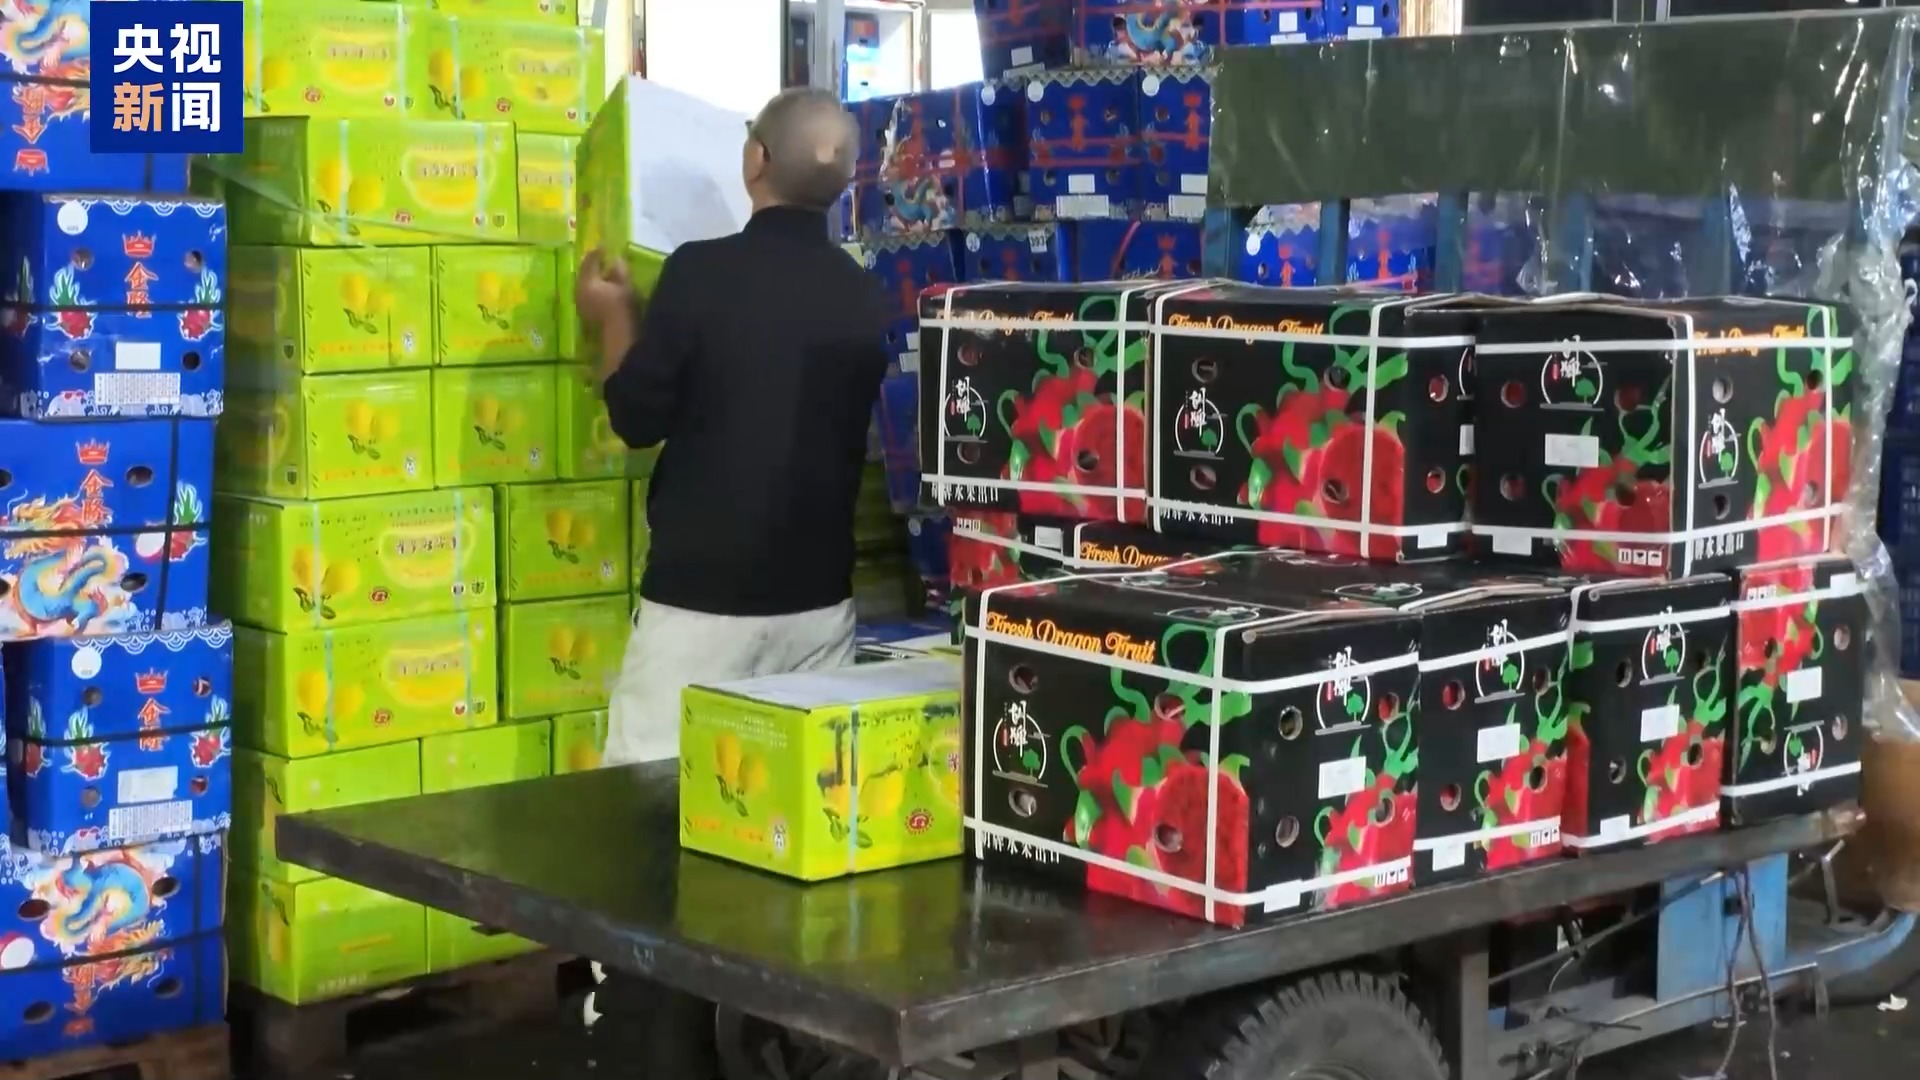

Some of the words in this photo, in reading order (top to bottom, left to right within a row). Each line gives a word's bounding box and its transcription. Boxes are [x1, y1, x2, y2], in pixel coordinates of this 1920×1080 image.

[987, 611, 1034, 639] Fresh
[1036, 619, 1102, 653] Dragon
[1104, 631, 1157, 665] Fruit
